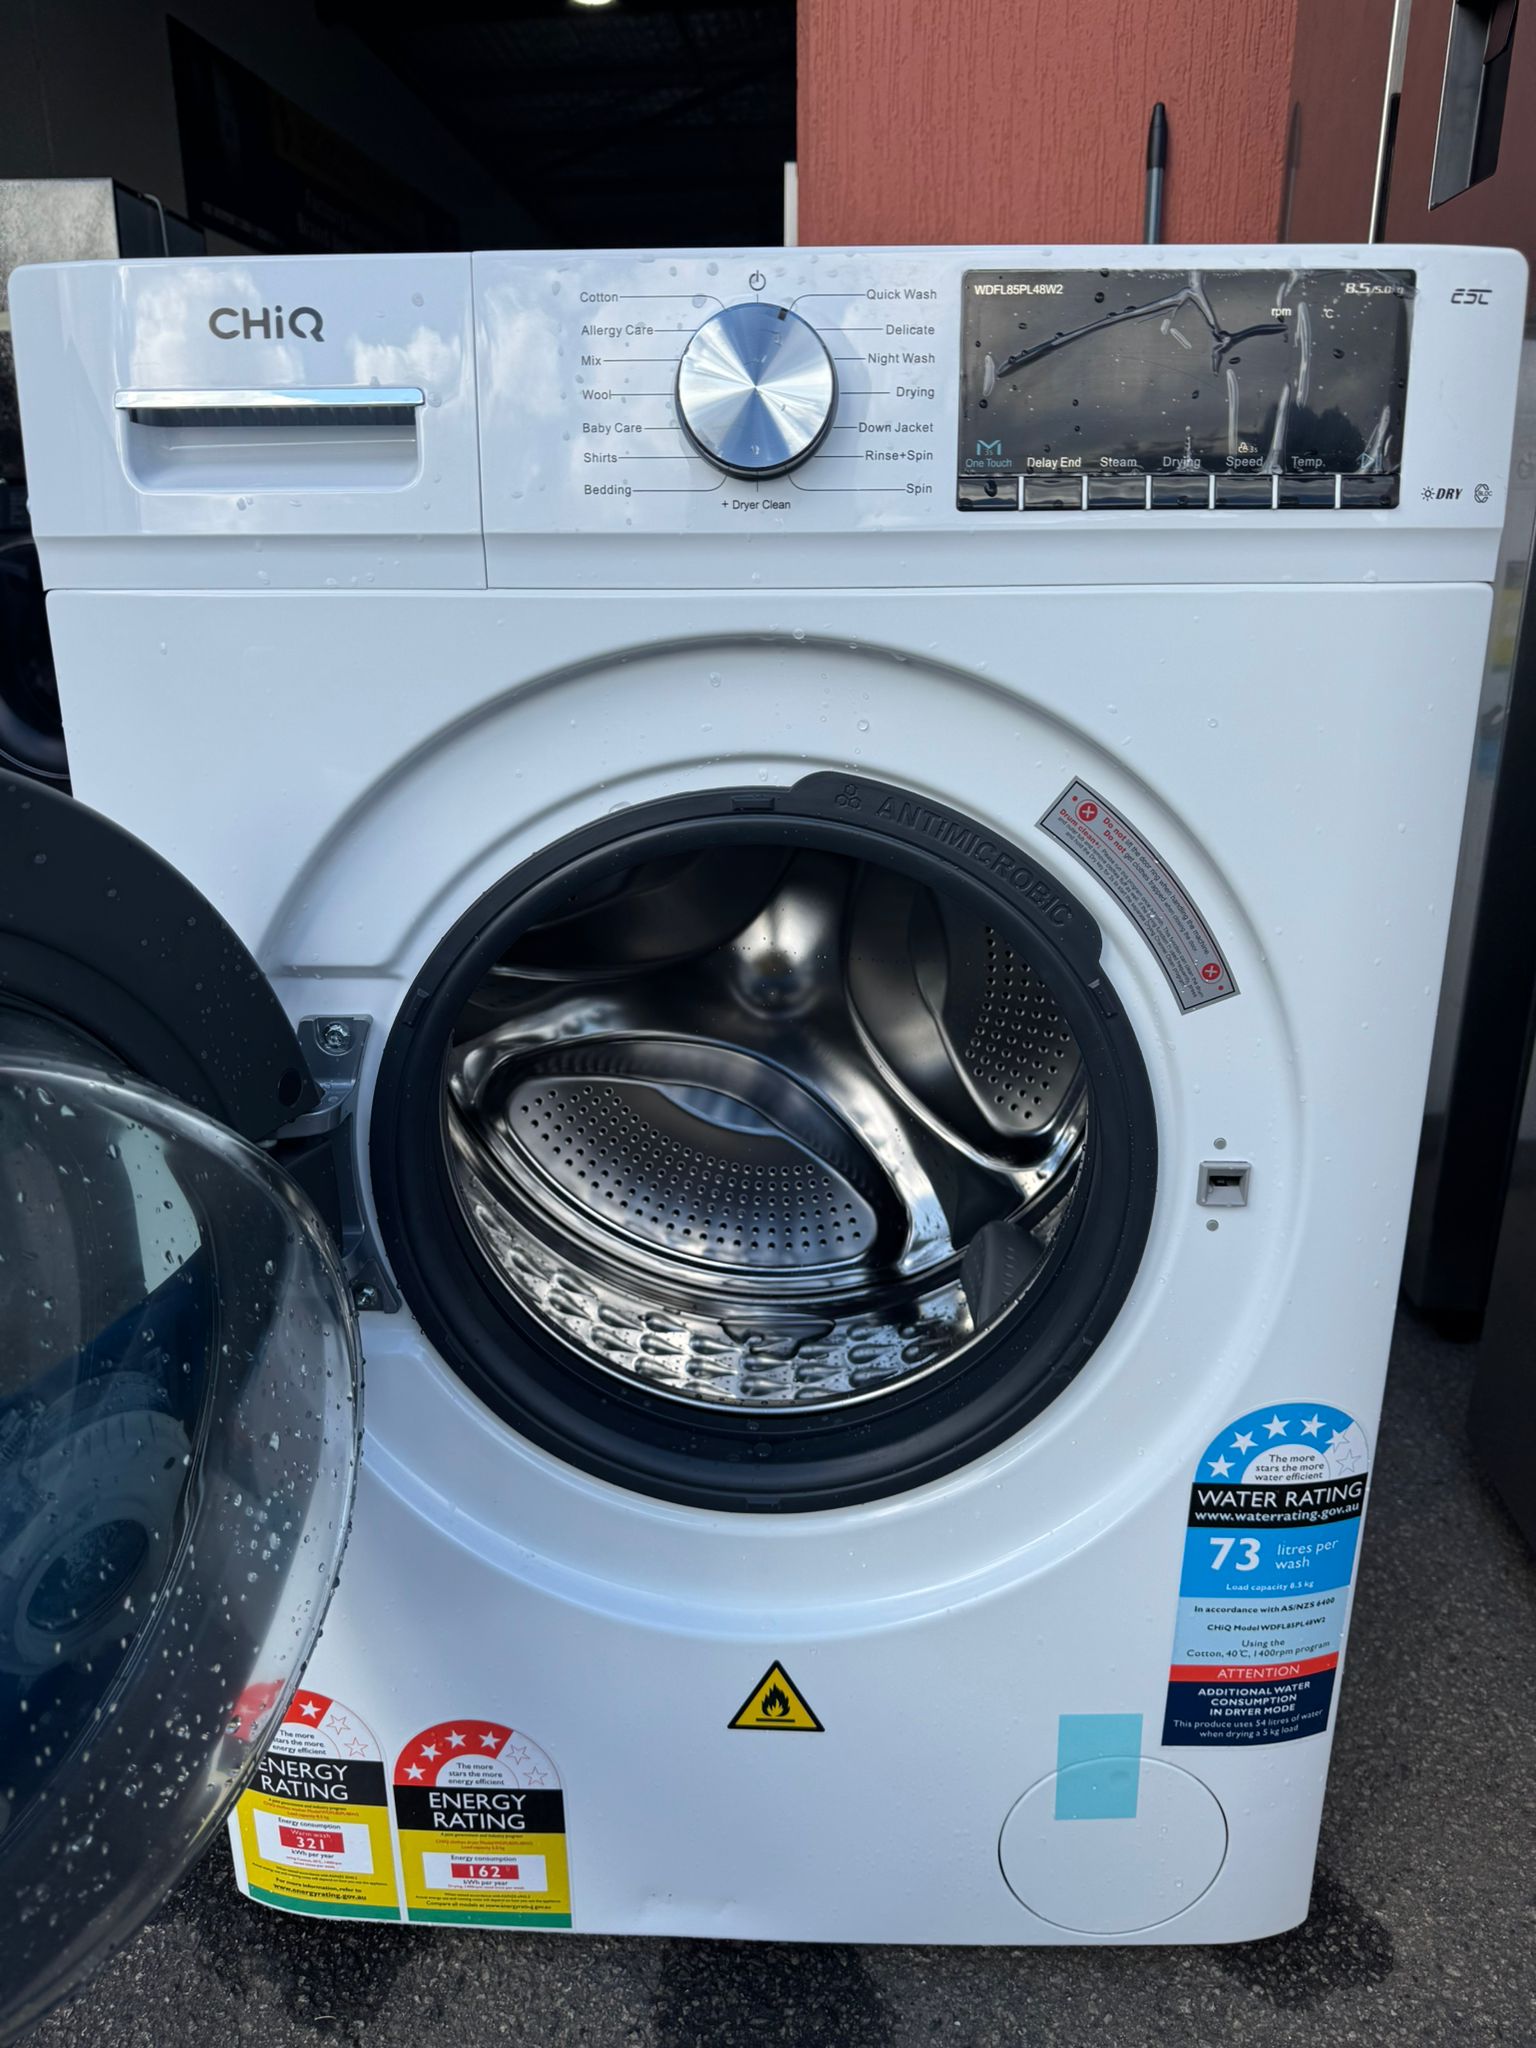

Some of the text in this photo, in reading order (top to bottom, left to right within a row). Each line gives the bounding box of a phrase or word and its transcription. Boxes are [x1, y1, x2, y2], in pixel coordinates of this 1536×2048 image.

[867, 289, 937, 301] Quick Wash
[974, 284, 1063, 295] WDFL85PL48W2
[580, 292, 618, 303] Cotton
[1271, 308, 1292, 317] rpm
[209, 306, 324, 342] CHiQ
[581, 325, 653, 337] Allergy Care
[886, 325, 934, 335] Delicate
[581, 356, 601, 365] Mix
[868, 354, 935, 365] Night Wash
[582, 390, 611, 400] Wool
[896, 387, 934, 399] Drying
[582, 423, 642, 434] Baby Care
[859, 422, 933, 433] Down Jacket
[584, 453, 618, 462] Shirts
[865, 451, 933, 462] Rinse+Spin
[1100, 457, 1137, 467] Steam
[966, 458, 1011, 467] One Touch
[1027, 457, 1081, 469] Delay End
[1163, 457, 1201, 470] Drying
[1226, 457, 1263, 468] Speed
[1292, 457, 1326, 468] Temp.
[584, 485, 631, 497] Bedding
[906, 483, 932, 495] Spin
[1436, 490, 1463, 499] DRY
[732, 500, 759, 512] Dryer
[762, 500, 791, 509] Clean
[1060, 809, 1078, 827] Drum
[876, 796, 1072, 926] ANTIMICROBIC
[1103, 830, 1115, 842] Do
[1114, 841, 1125, 853] not
[1123, 852, 1134, 864] get
[1131, 862, 1150, 881] clothes
[1102, 817, 1115, 829] Do
[1114, 829, 1126, 840] not
[1131, 846, 1142, 857] the
[1139, 857, 1151, 869] door
[1149, 870, 1160, 881] ring
[1159, 880, 1171, 895] when
[1169, 896, 1190, 920] handling
[1186, 920, 1195, 930] the
[1193, 930, 1209, 954] machine
[1269, 1454, 1315, 1462] The more
[1300, 1463, 1324, 1471] more
[1287, 1472, 1323, 1480] efficient
[1198, 1482, 1362, 1508] WATER RATING
[1195, 1503, 1359, 1522] www.waterrating.gov.au
[1210, 1537, 1337, 1570] 73 litres per
[1275, 1558, 1309, 1569] wash
[1281, 1601, 1314, 1612] AS/NZS
[1317, 1597, 1335, 1607] 6400
[1187, 1650, 1224, 1658] Cotton,
[1254, 1648, 1293, 1659] 1400rpm
[1295, 1641, 1330, 1655] program
[1217, 1665, 1300, 1679] ATTENTION
[1274, 1681, 1310, 1694] WATER
[1211, 1694, 1297, 1705] CONSUMPTION
[1264, 1704, 1295, 1714] MODE
[1291, 1715, 1300, 1723] of
[1301, 1709, 1322, 1719] water
[280, 1729, 292, 1737] The
[272, 1745, 326, 1755] energy efficient
[258, 1756, 348, 1781] ENERGY
[262, 1776, 348, 1800] RATING
[429, 1792, 526, 1810] ENERGY
[278, 1818, 341, 1830] Energy consumption
[434, 1814, 525, 1830] RATING
[291, 1829, 311, 1837] Warm
[296, 1838, 326, 1850] 321
[291, 1849, 305, 1857] kWh
[451, 1855, 473, 1863] Energy
[469, 1866, 500, 1877] 162
[274, 1883, 366, 1900] www.energyrating.gov.au
